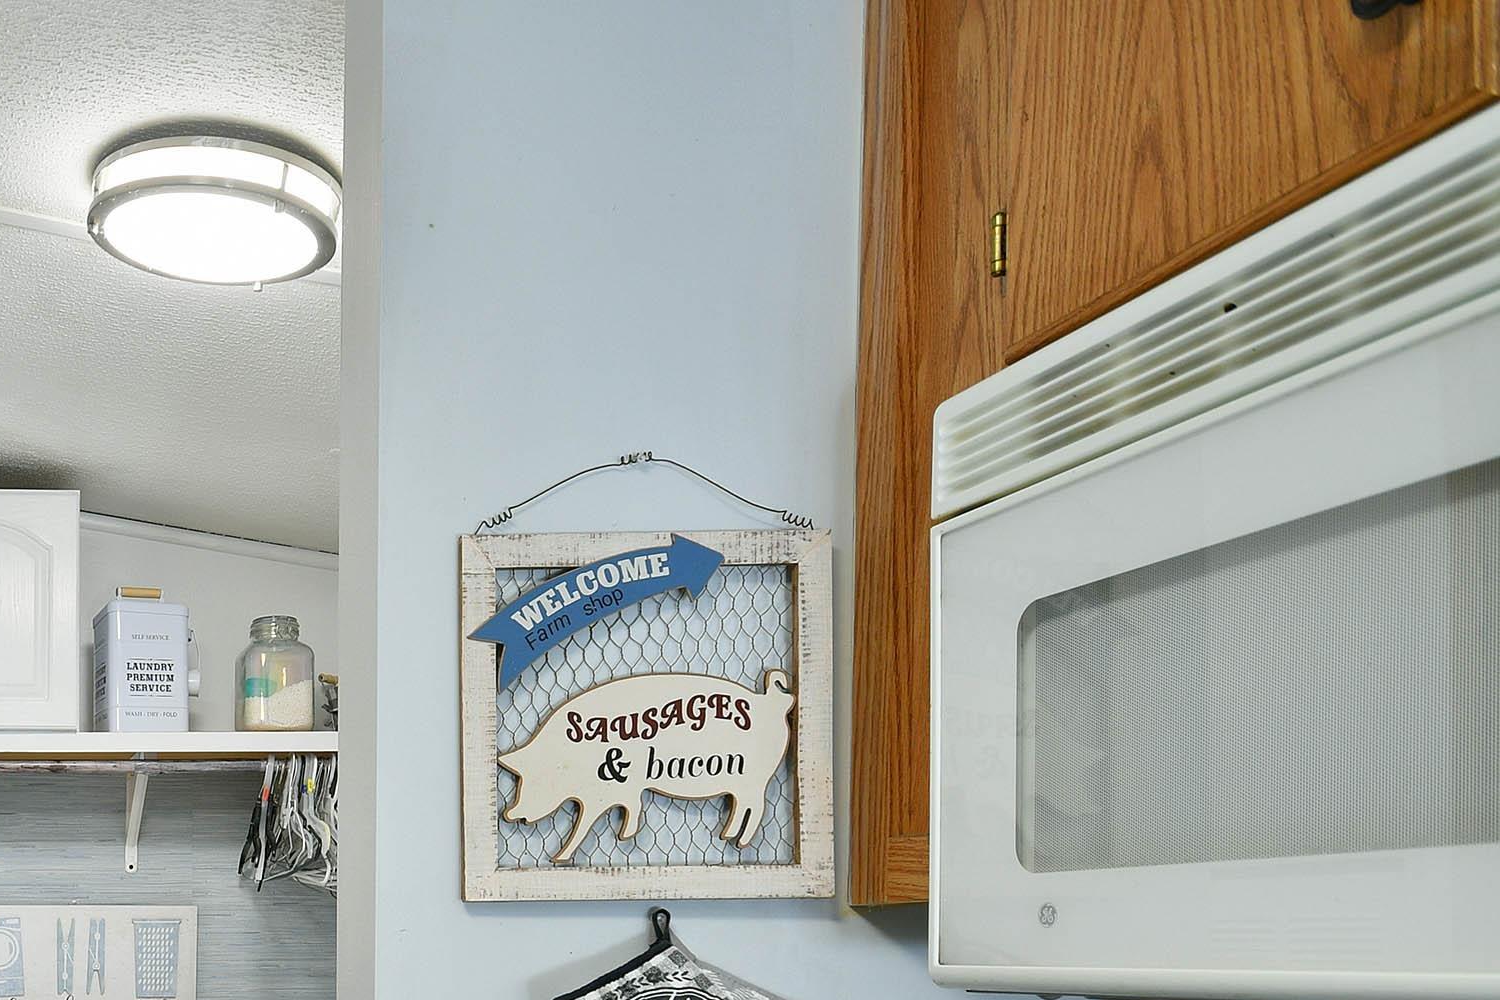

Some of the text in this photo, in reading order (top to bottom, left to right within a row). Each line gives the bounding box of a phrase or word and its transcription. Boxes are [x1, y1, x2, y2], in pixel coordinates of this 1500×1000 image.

[510, 553, 670, 631] WELCOME
[524, 588, 624, 651] Farm shop
[131, 633, 144, 641] SELF
[126, 662, 175, 671] LAUNDRY
[126, 673, 175, 682] PREMIUM
[129, 684, 172, 692] SERVICE
[566, 694, 751, 743] SAUSAGES
[597, 746, 745, 783] & bacon
